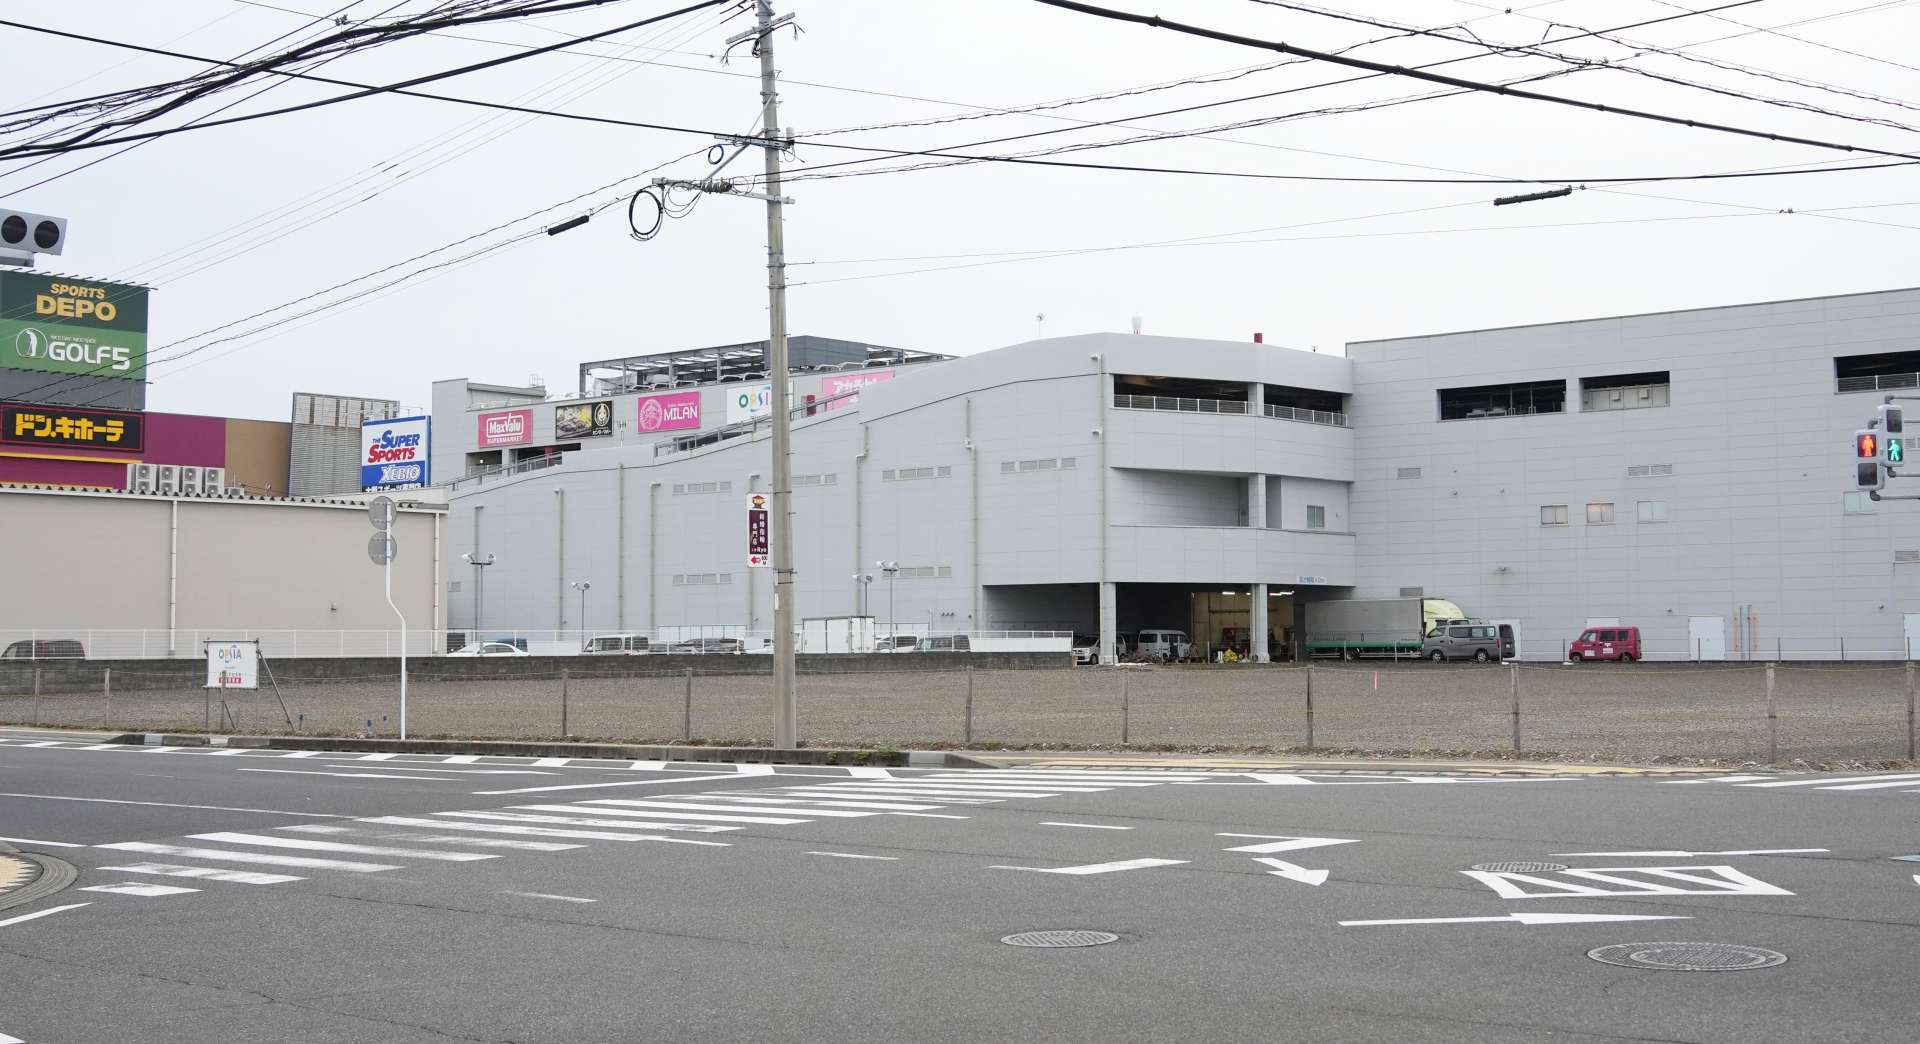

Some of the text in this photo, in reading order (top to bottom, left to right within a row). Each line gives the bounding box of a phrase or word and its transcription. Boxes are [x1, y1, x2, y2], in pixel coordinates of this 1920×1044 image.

[50, 283, 105, 299] SPORTS
[36, 294, 117, 321] DEPO
[663, 405, 698, 421] MILAN
[489, 413, 522, 434] MaxValu
[381, 429, 420, 449] SUPER
[368, 444, 415, 463] SPORTS
[379, 464, 421, 484] XEBIO
